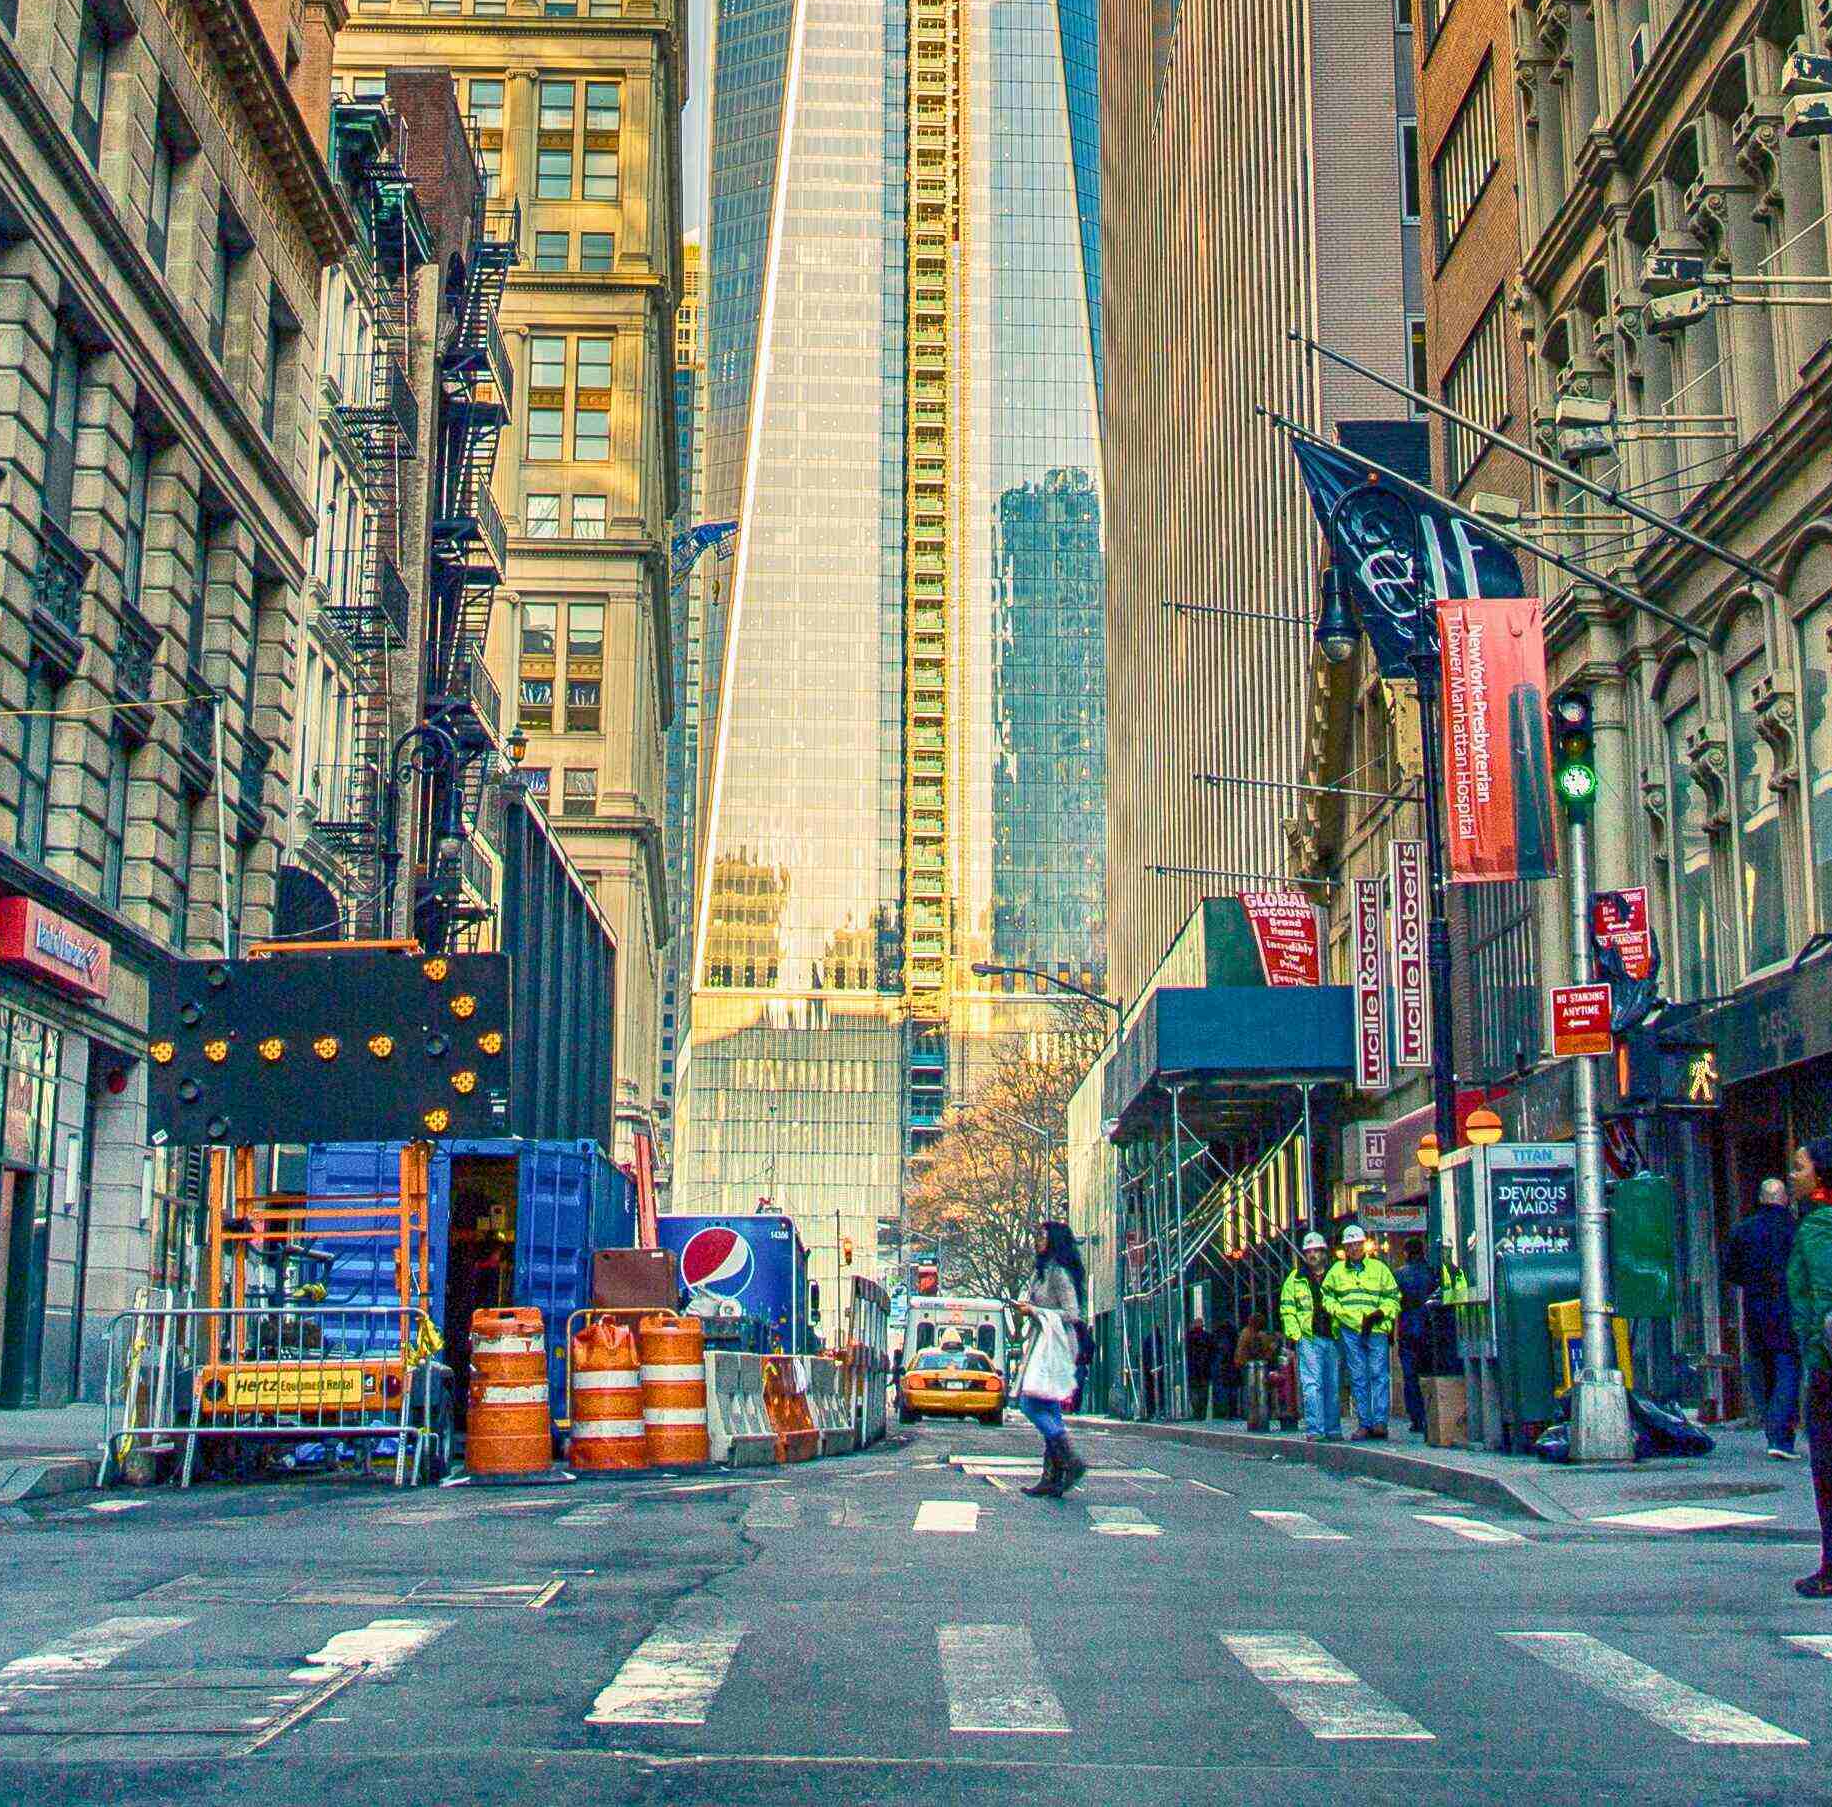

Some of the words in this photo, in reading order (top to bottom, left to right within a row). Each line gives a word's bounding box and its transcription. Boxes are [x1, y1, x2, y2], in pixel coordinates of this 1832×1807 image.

[1449, 678, 1468, 768] Manhattan
[1455, 771, 1476, 840] Hospital
[1243, 893, 1310, 910] GLOBAL
[1399, 844, 1419, 962] Roberts
[1248, 908, 1311, 920] DISCOUNT
[1360, 881, 1380, 992] Roberts
[1569, 990, 1607, 1003] STANDING
[1406, 966, 1422, 1063] Lucille
[1562, 1004, 1600, 1017] ANYTIME
[1364, 995, 1381, 1085] Lucille
[1512, 1149, 1553, 1162] TITAN
[1498, 1185, 1567, 1201] DEVIOUS
[1508, 1200, 1558, 1217] MAIDS
[236, 1378, 278, 1393] Hertz
